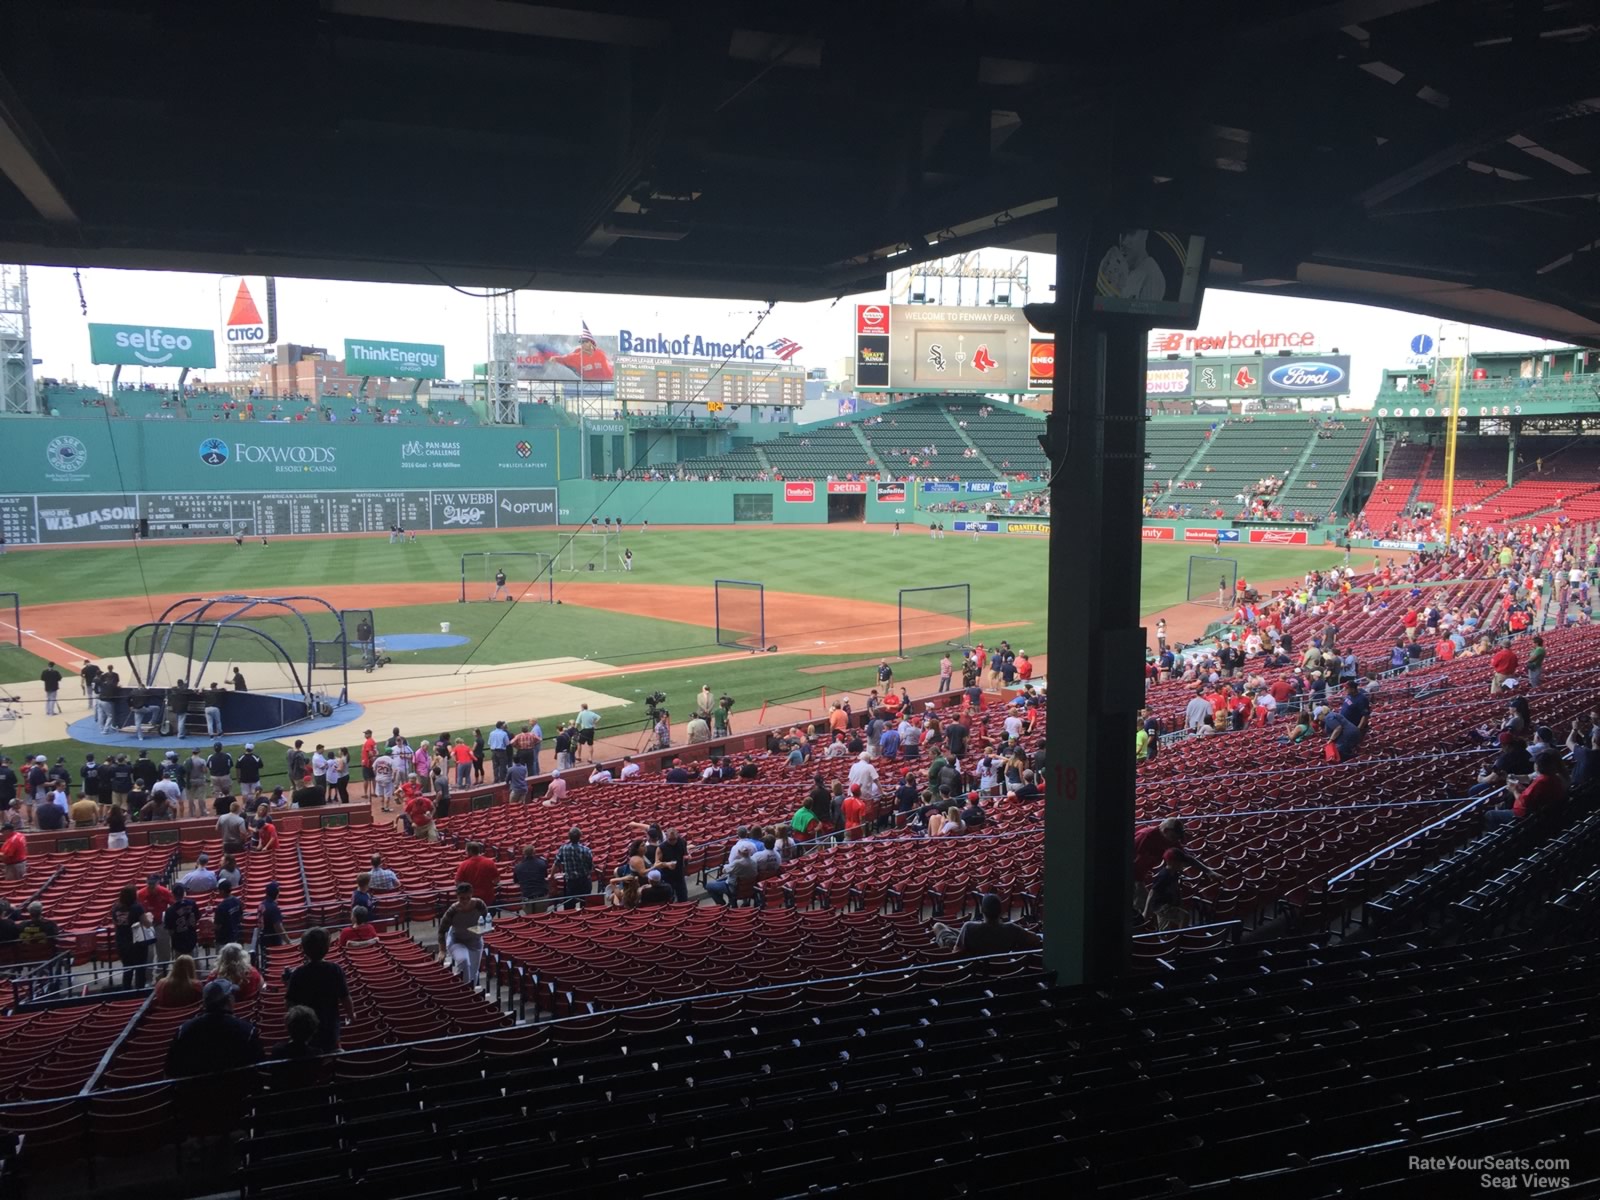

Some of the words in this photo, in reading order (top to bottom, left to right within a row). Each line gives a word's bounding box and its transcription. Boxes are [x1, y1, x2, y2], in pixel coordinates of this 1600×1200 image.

[905, 311, 945, 320] WELCOME
[947, 312, 958, 320] TO
[959, 313, 992, 321] FENWAY
[994, 314, 1015, 322] PARK
[227, 327, 264, 342] CITGO
[620, 330, 668, 354] Bank
[672, 334, 690, 355] of
[692, 335, 765, 360] America
[351, 344, 438, 367] ThinkEnergy
[1032, 356, 1054, 364] ENEO
[1283, 366, 1327, 384] Ford
[1147, 382, 1184, 390] ONUTS
[592, 424, 624, 432] ABIOMED
[235, 443, 336, 462] FOXWOODS
[834, 483, 861, 492] aetna
[970, 482, 990, 491] NESN
[434, 494, 455, 505] F.W.
[458, 493, 494, 504] WEBB
[513, 502, 553, 514] OPTUM
[1008, 524, 1037, 532] GRANITE
[1054, 764, 1076, 800] 18
